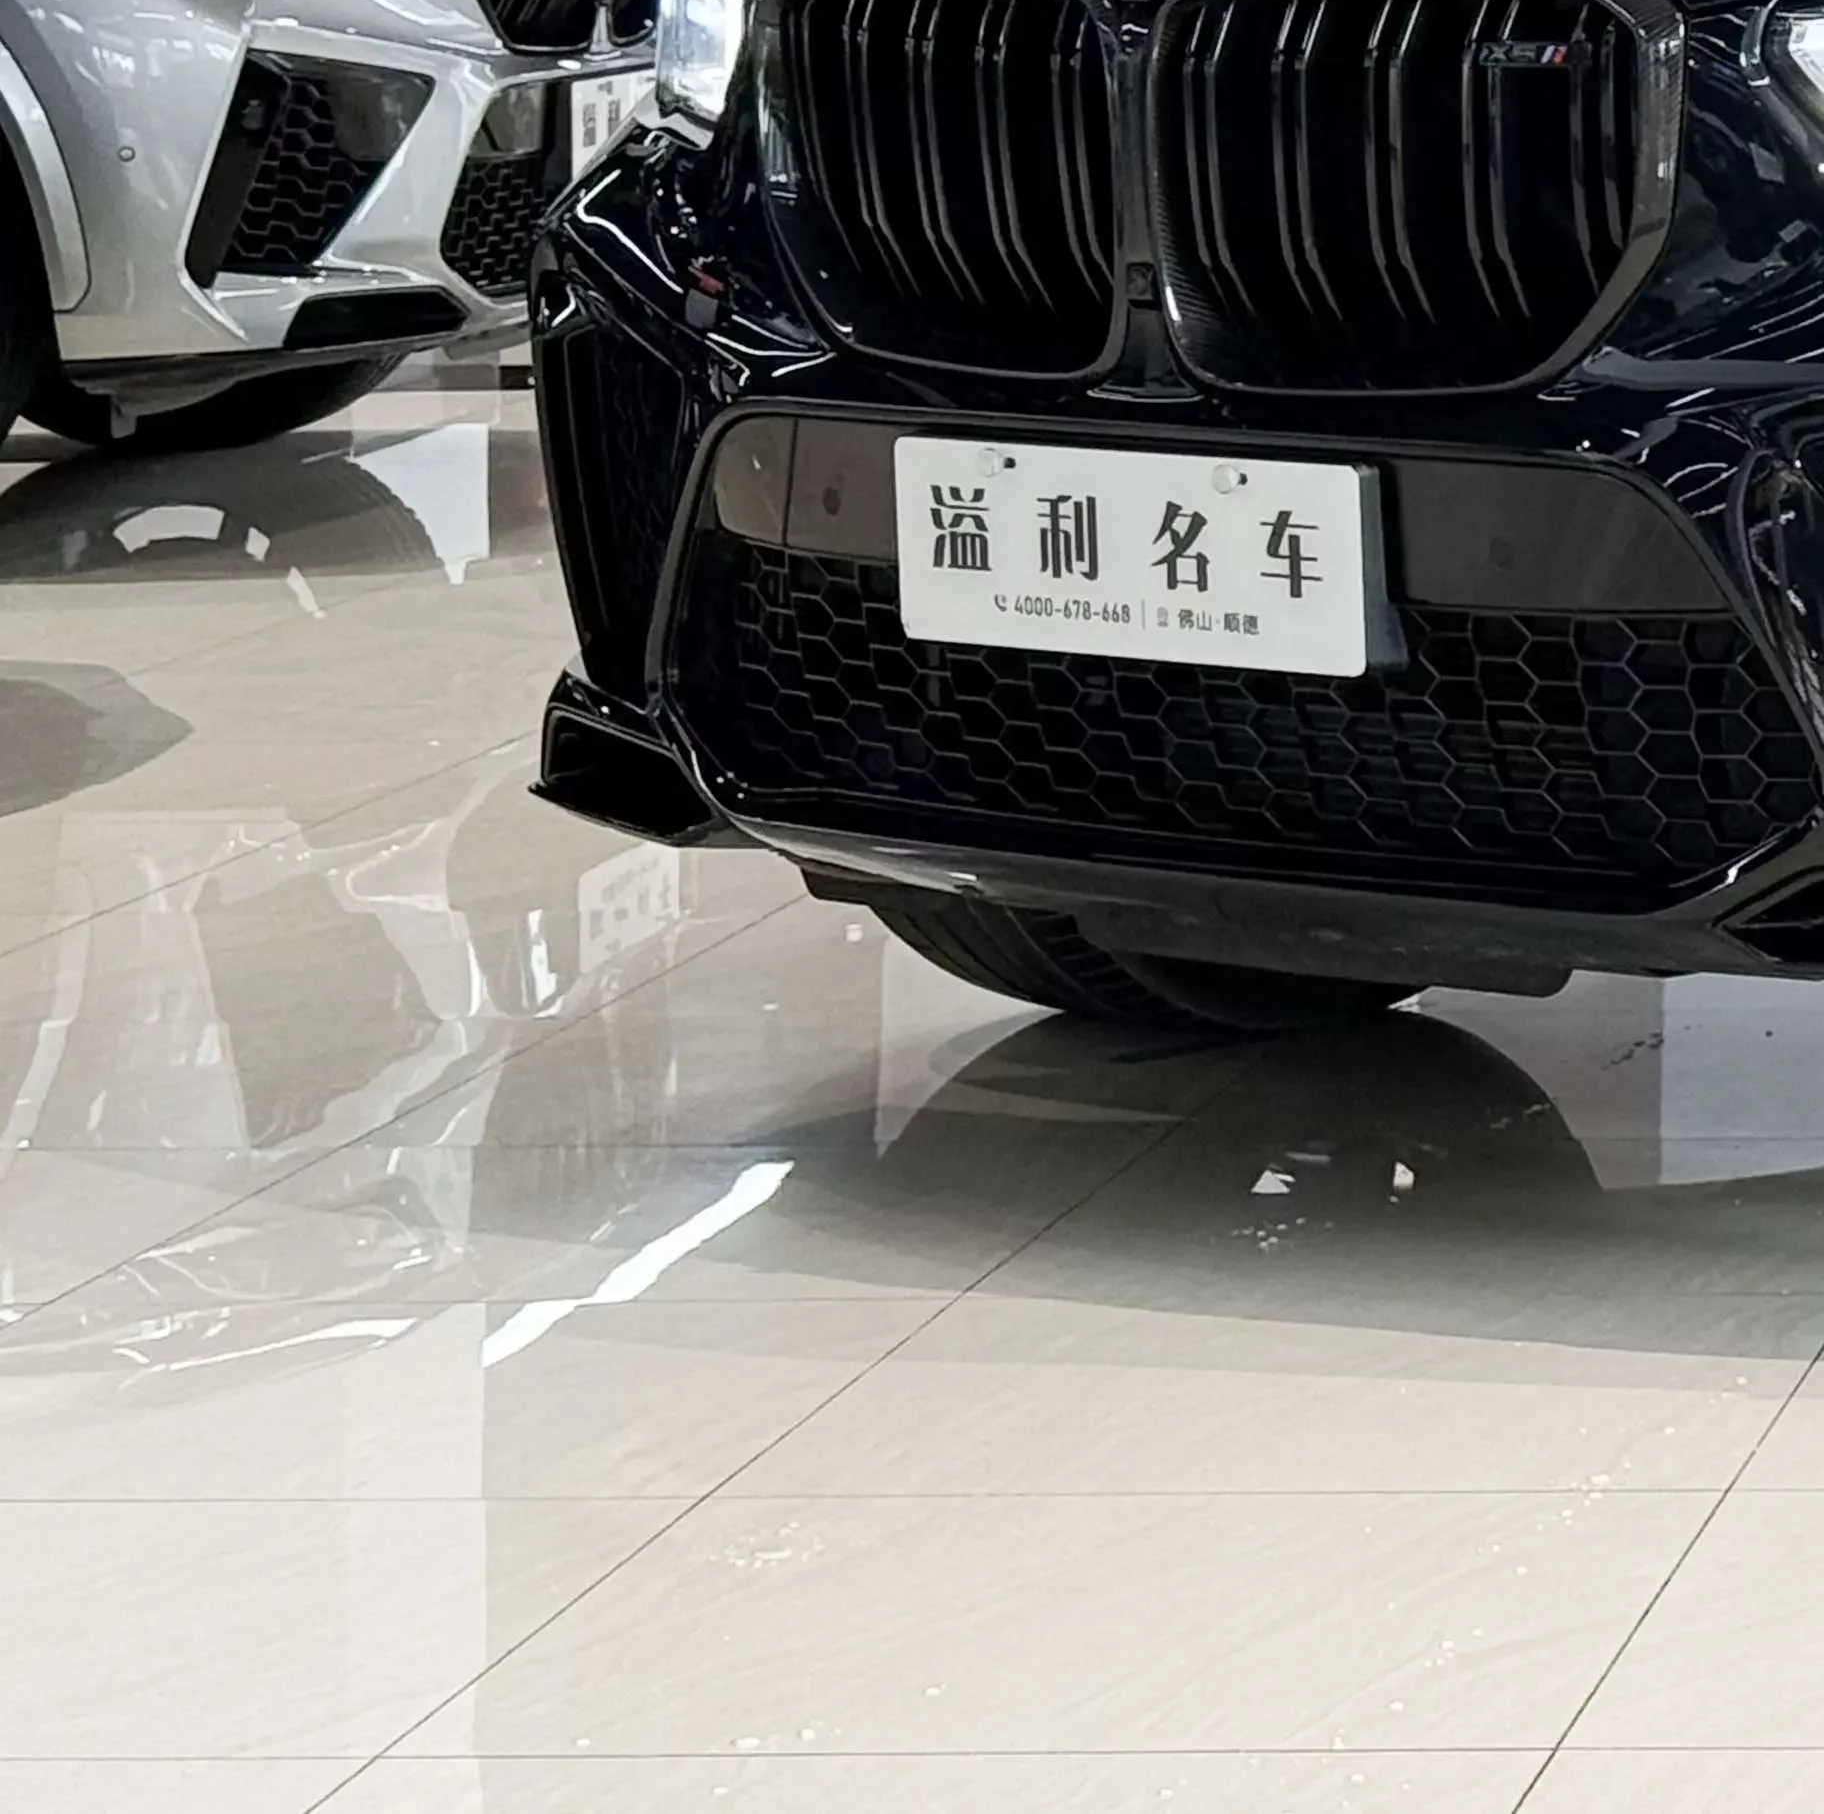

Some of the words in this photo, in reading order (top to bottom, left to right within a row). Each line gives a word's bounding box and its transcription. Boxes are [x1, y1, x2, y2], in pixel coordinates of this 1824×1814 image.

[930, 484, 1323, 599] 溢利名车
[1014, 595, 1132, 624] 4000-678-668
